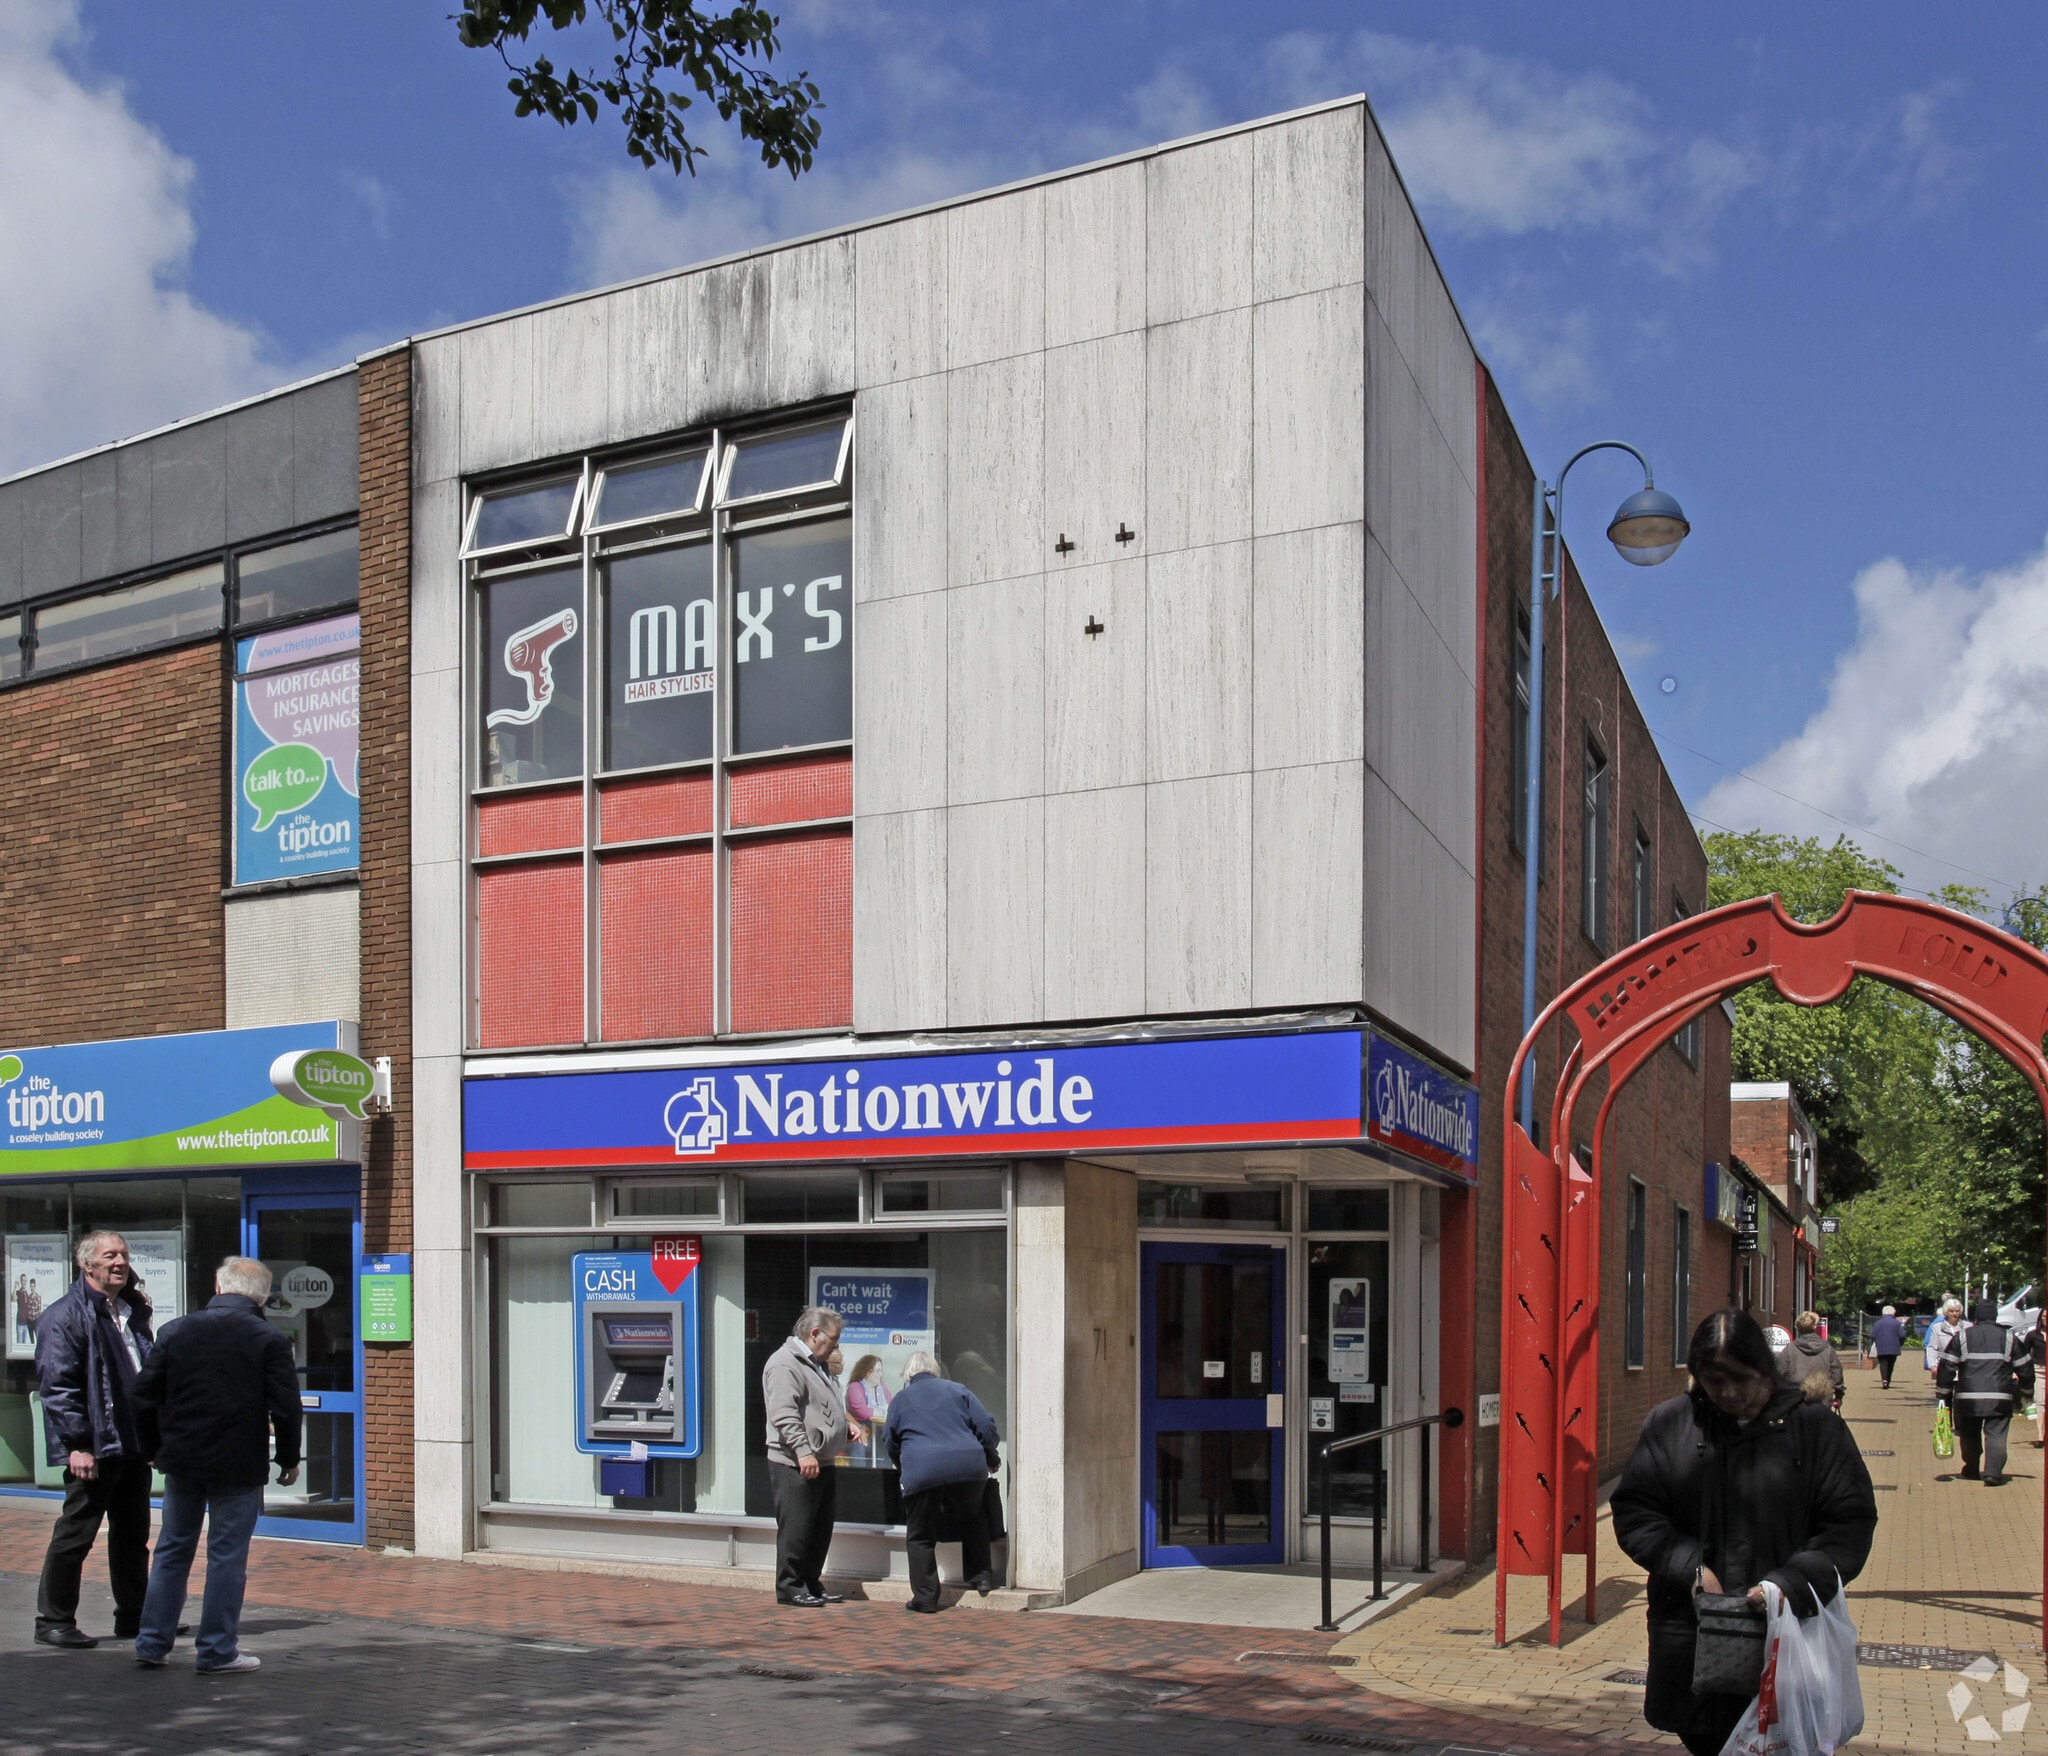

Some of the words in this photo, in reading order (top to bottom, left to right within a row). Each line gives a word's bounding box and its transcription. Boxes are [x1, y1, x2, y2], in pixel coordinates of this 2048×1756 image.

[629, 574, 842, 679] MAX'S
[257, 627, 360, 658] www.thetipton.co.uk
[266, 661, 360, 698] MORTGAGES
[628, 681, 657, 700] HAIR
[660, 672, 714, 695] STYLISTS
[274, 684, 360, 719] INSURANCE
[293, 708, 360, 737] SAVINGS
[249, 769, 283, 793] talk
[285, 766, 320, 786] to...
[295, 814, 311, 826] the
[278, 819, 351, 852] tipton
[306, 849, 329, 860] building
[329, 846, 351, 856] society
[1585, 930, 1758, 1033] HOMERS
[1897, 924, 2008, 989] FOLD
[318, 1058, 332, 1066] the
[29, 1075, 51, 1091] the
[304, 1062, 366, 1086] tipton
[733, 1058, 1094, 1137] Nationwide
[7, 1085, 105, 1131] tipton
[1396, 1065, 1473, 1157] Nationwide
[9, 1134, 15, 1143] &
[15, 1132, 44, 1143] coseley
[44, 1130, 75, 1142] building
[75, 1129, 104, 1140] society
[176, 1124, 330, 1150] www.thetipton.co.uk
[22, 1244, 52, 1253] Mortgages
[131, 1243, 164, 1252] Mortgages
[654, 1239, 697, 1261] FREE
[29, 1255, 40, 1263] first
[137, 1255, 150, 1263] first
[152, 1255, 166, 1263] time
[36, 1267, 55, 1276] buyers
[145, 1267, 167, 1276] buyers
[584, 1270, 636, 1291] CASH
[288, 1276, 328, 1293] tipton
[822, 1282, 857, 1297] Can't
[861, 1283, 892, 1298] wait
[586, 1292, 636, 1301] WITHDRAWALS
[821, 1300, 836, 1312] to
[840, 1301, 863, 1314] see
[867, 1300, 890, 1315] us?
[622, 1328, 668, 1337] Nationwide
